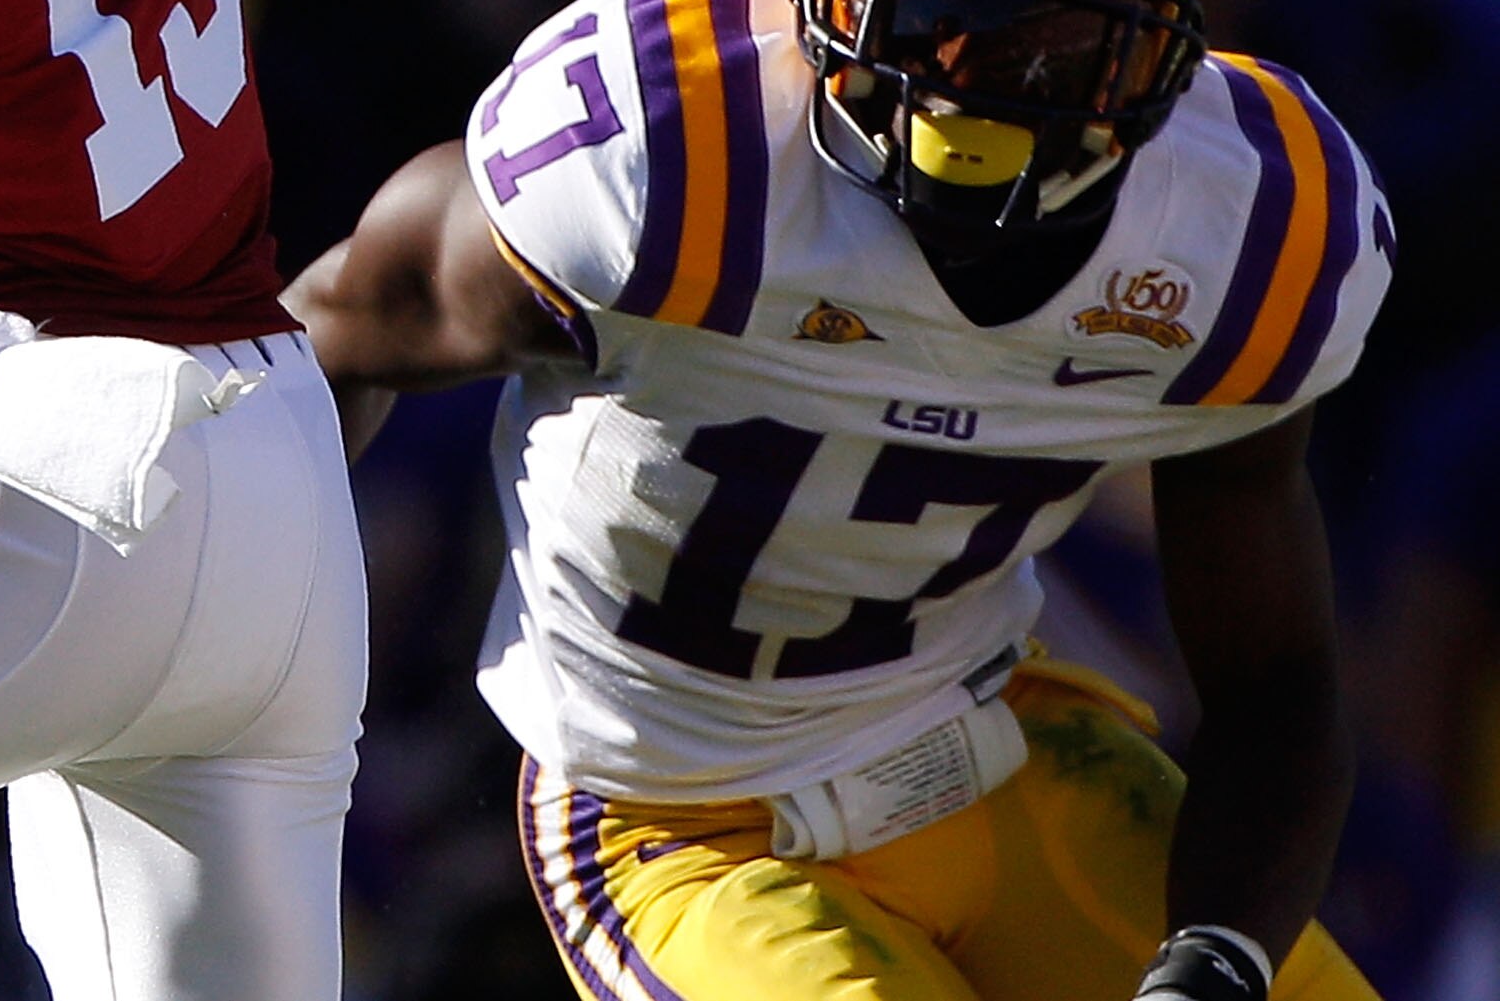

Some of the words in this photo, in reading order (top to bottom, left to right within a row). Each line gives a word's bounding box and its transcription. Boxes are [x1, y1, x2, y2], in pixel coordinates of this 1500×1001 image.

[480, 12, 626, 207] 17
[880, 399, 979, 440] LSU
[614, 415, 1108, 681] 17
